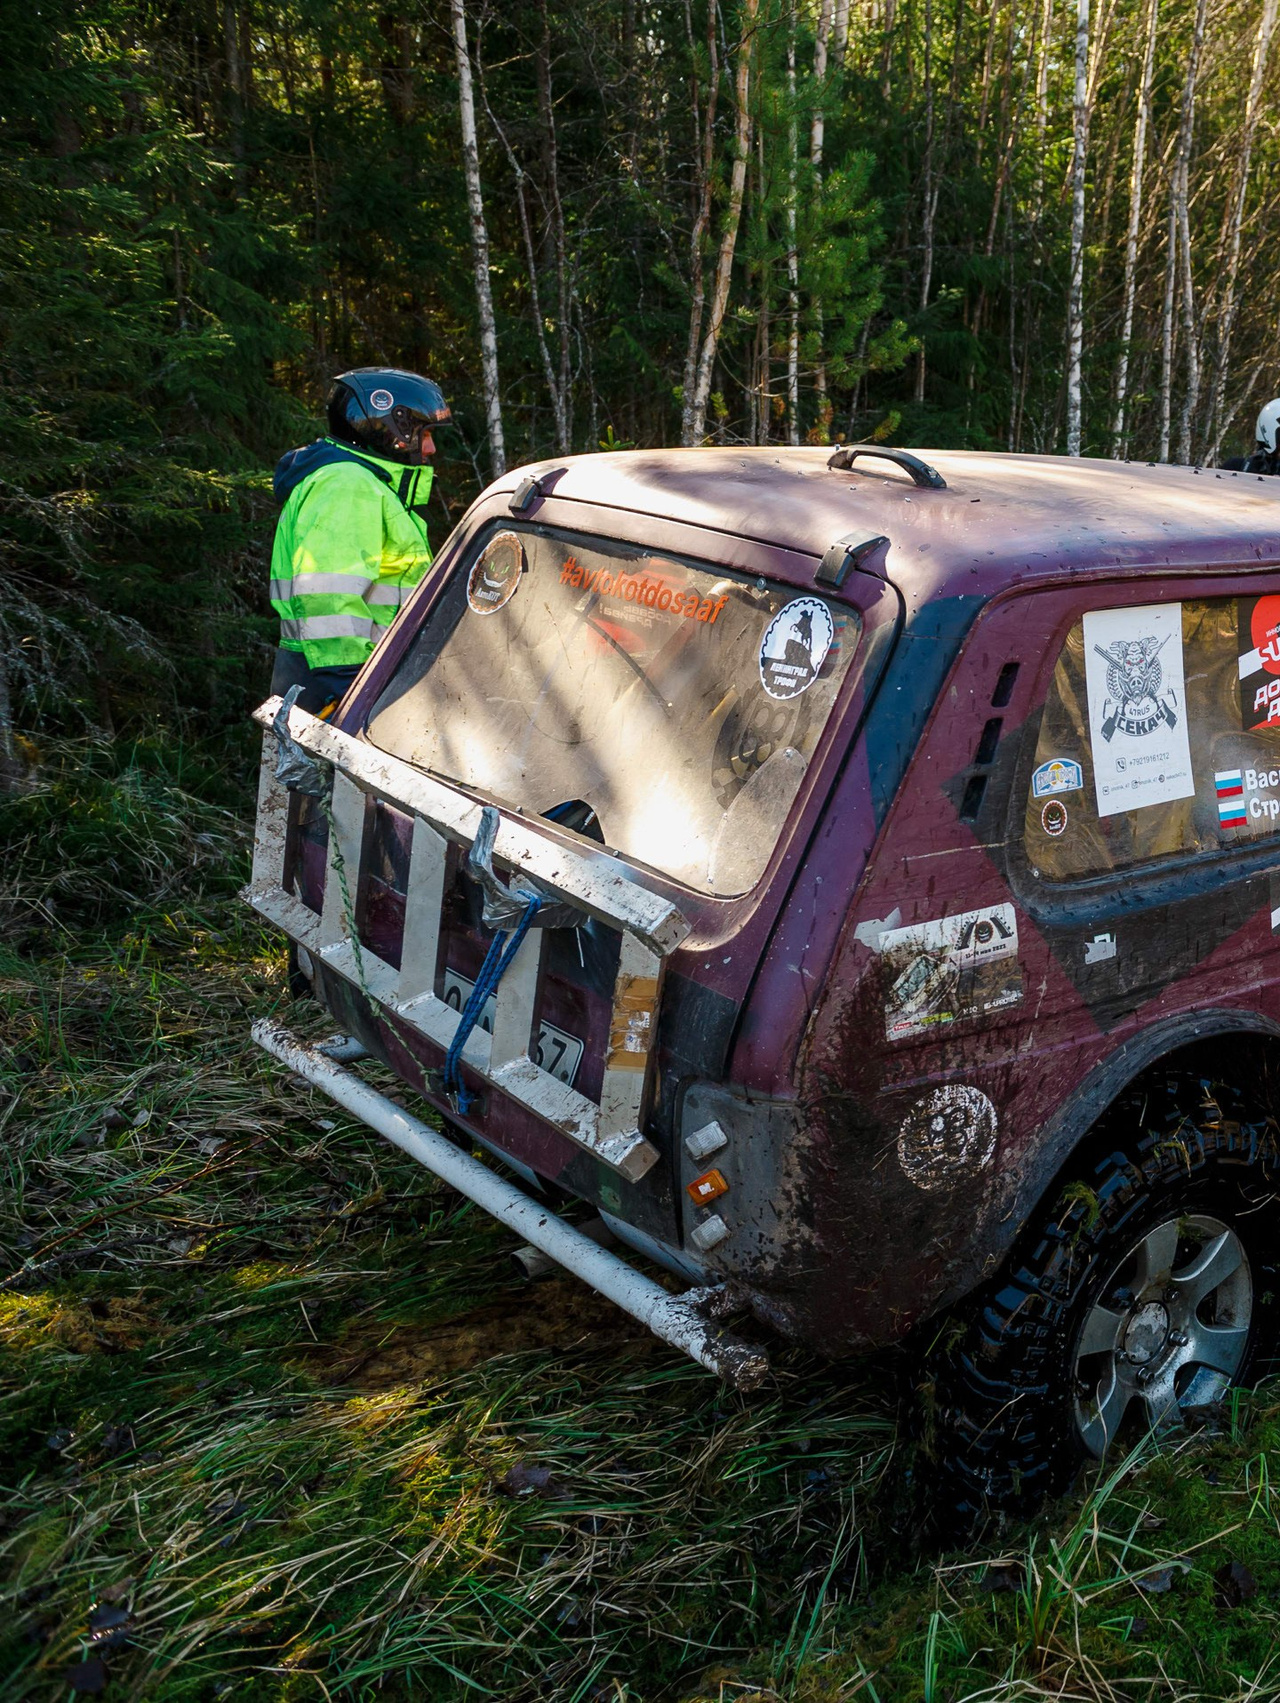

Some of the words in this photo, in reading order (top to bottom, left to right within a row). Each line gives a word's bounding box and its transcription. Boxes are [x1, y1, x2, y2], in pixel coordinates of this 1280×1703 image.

[559, 556, 729, 624] #avtokotdosaaf
[769, 662, 808, 677] ЛЕНИНГРАД
[773, 675, 797, 688] ТРОФИ
[1116, 708, 1167, 735] СЕКАЧ
